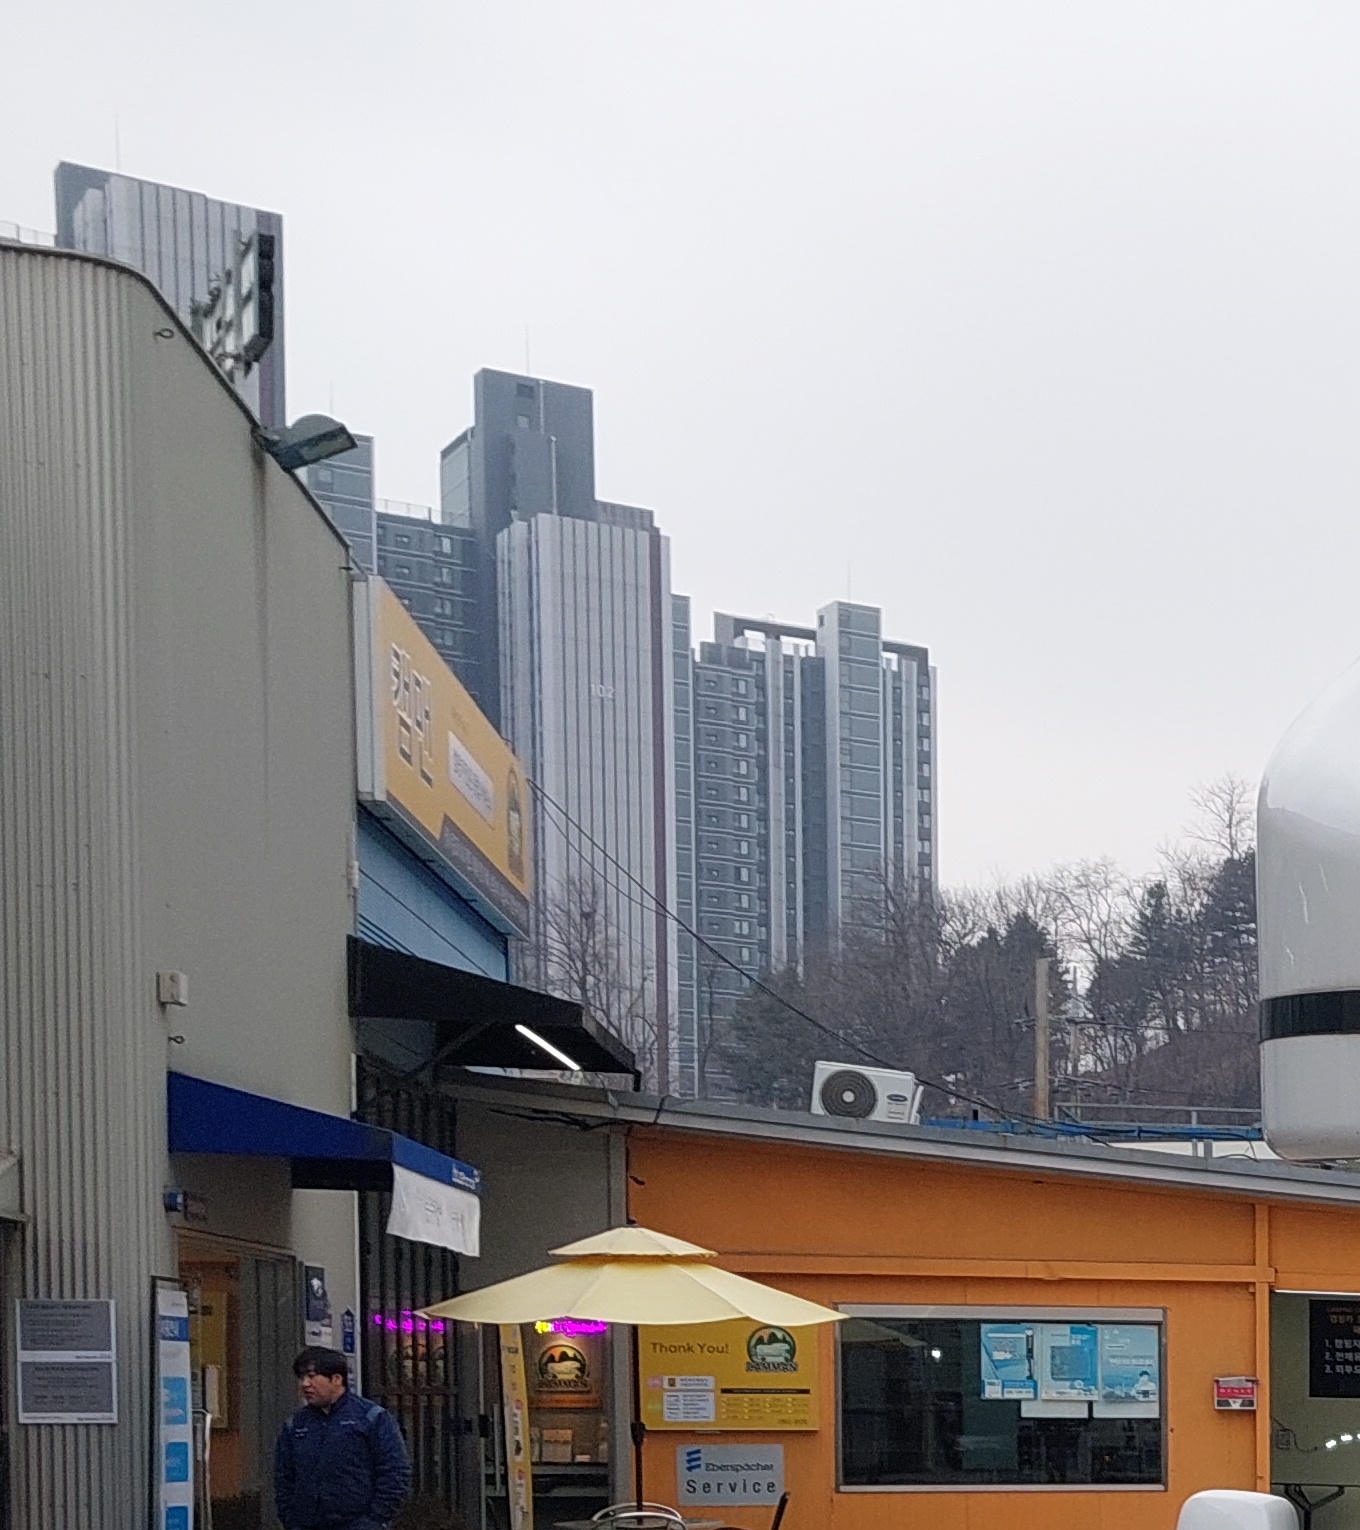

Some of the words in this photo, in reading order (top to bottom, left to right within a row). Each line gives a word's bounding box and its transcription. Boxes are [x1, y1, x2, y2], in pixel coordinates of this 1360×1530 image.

[651, 1342, 695, 1354] Thank
[697, 1343, 730, 1355] You!
[686, 1479, 776, 1494] Service
